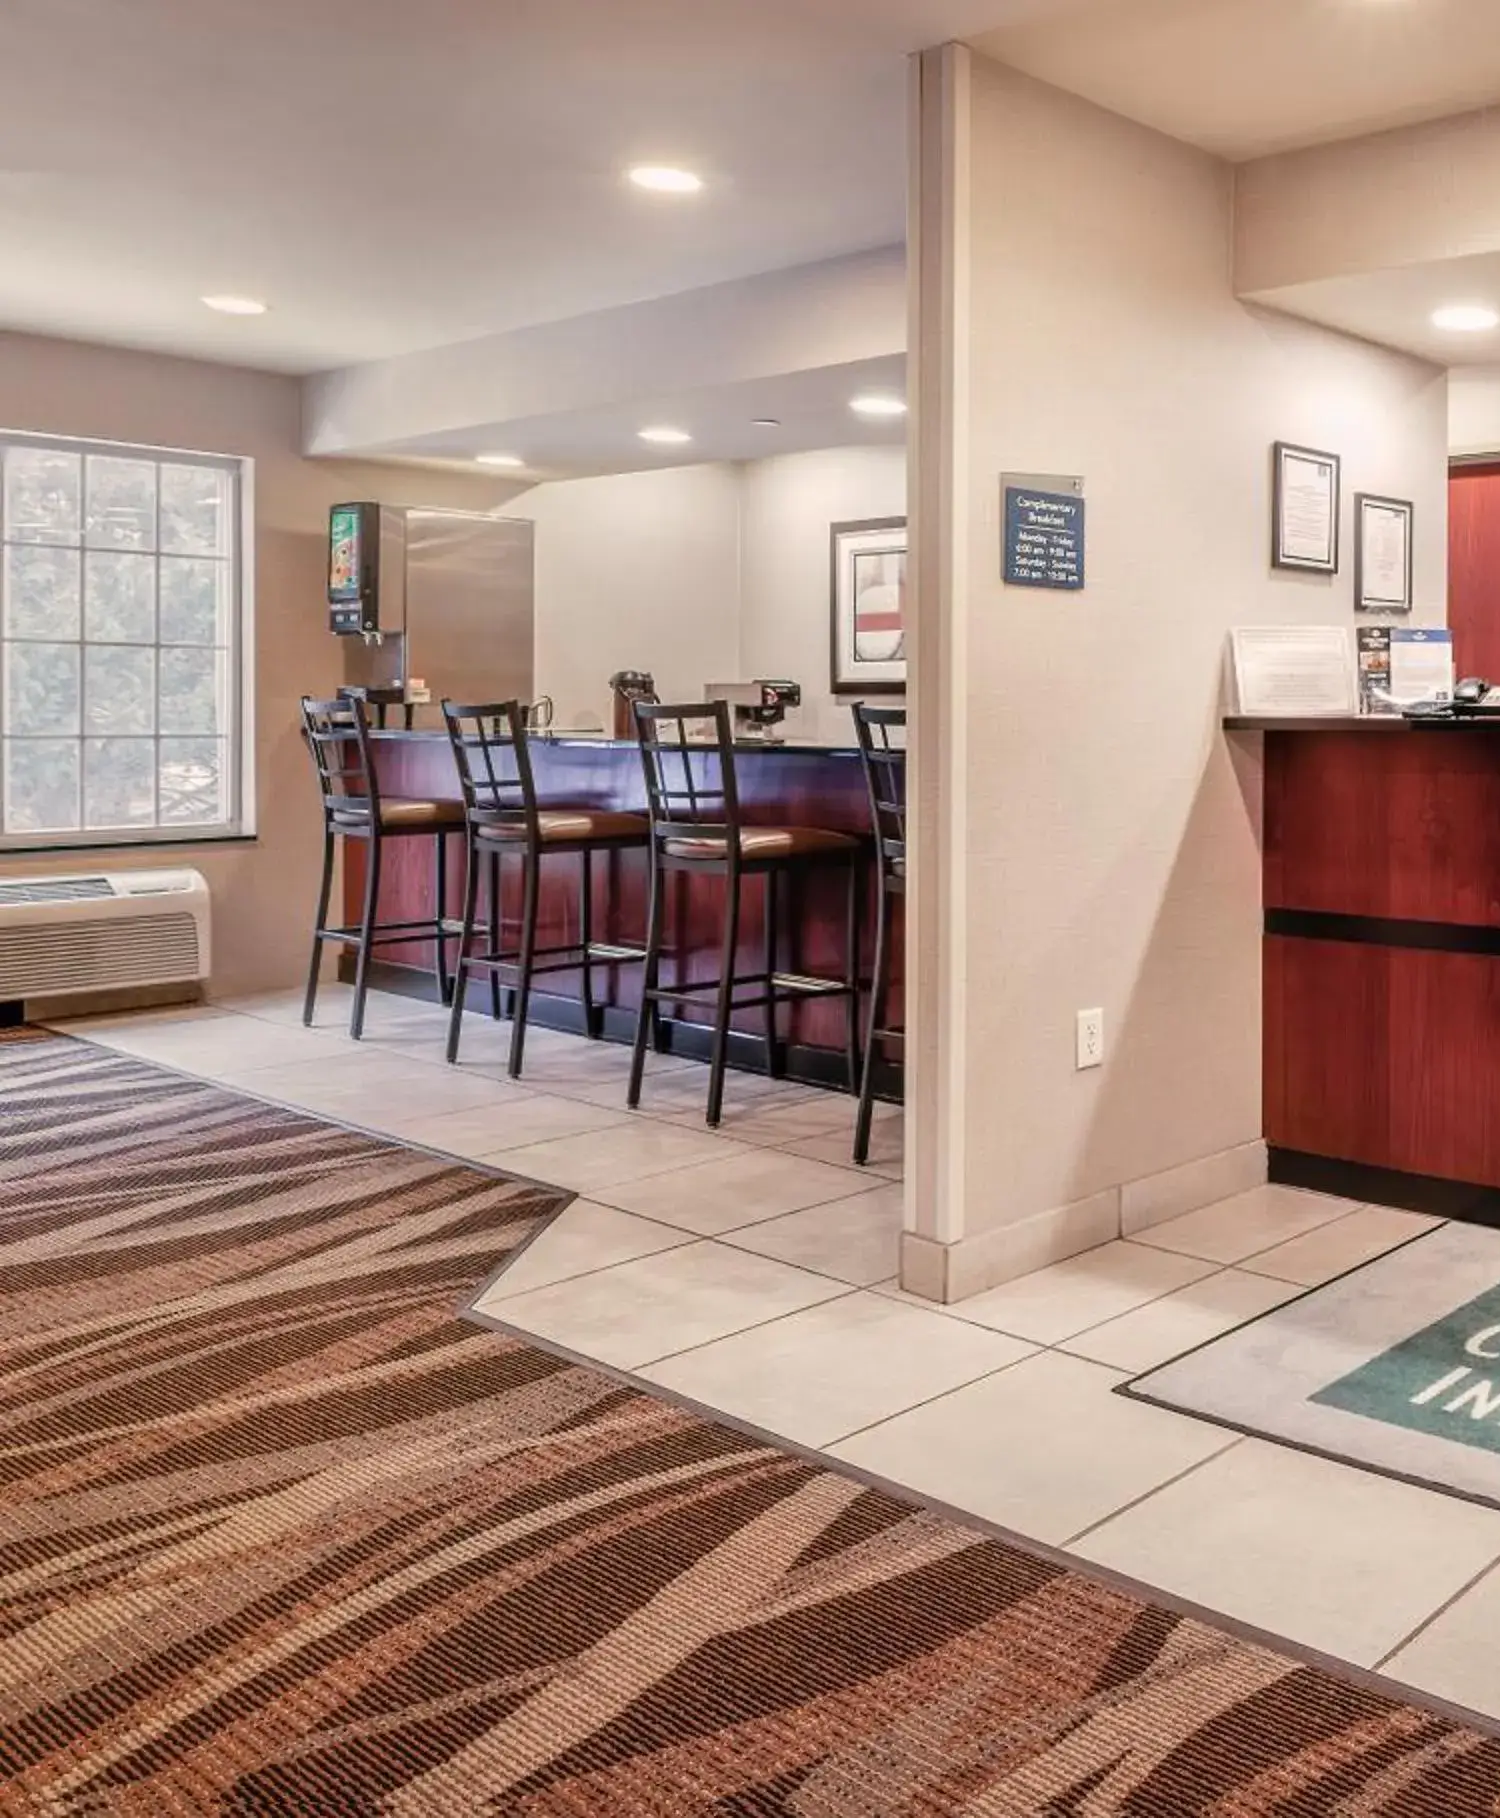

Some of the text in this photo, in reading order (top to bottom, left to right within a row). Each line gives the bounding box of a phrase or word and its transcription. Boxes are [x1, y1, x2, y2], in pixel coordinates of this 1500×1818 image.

[1016, 496, 1076, 517] Complimentary
[1028, 512, 1065, 526] Breakfast
[1018, 531, 1074, 549] Monday Friday
[1016, 556, 1046, 568] Saturday
